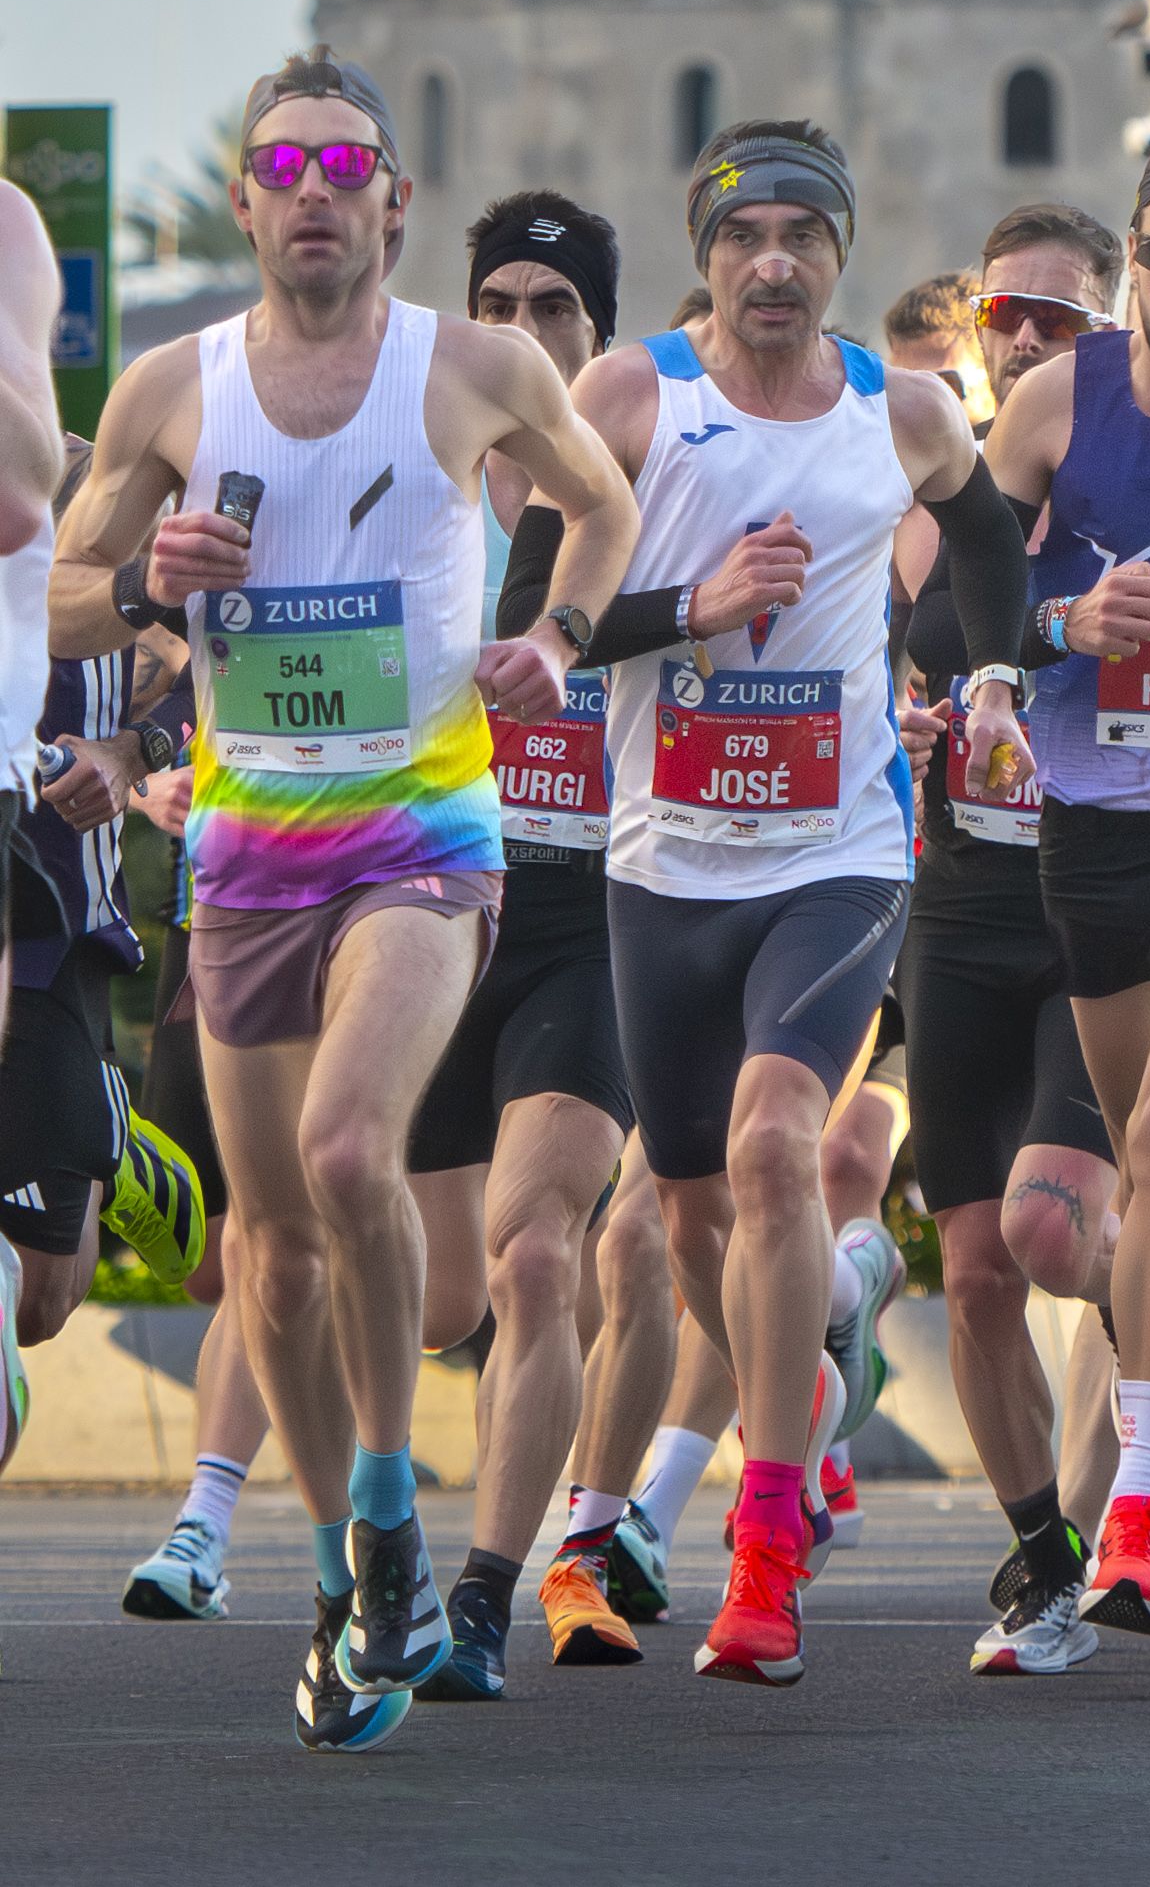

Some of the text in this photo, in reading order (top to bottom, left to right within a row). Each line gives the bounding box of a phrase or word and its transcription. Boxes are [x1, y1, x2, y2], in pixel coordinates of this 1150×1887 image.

[265, 594, 377, 623] ZURICH
[280, 654, 323, 678] 544
[566, 691, 608, 712] RIC
[718, 683, 820, 704] ZURICH
[264, 690, 345, 727] TOM
[525, 735, 567, 760] 662
[725, 735, 769, 758] 679
[700, 761, 790, 804] JOSÉ
